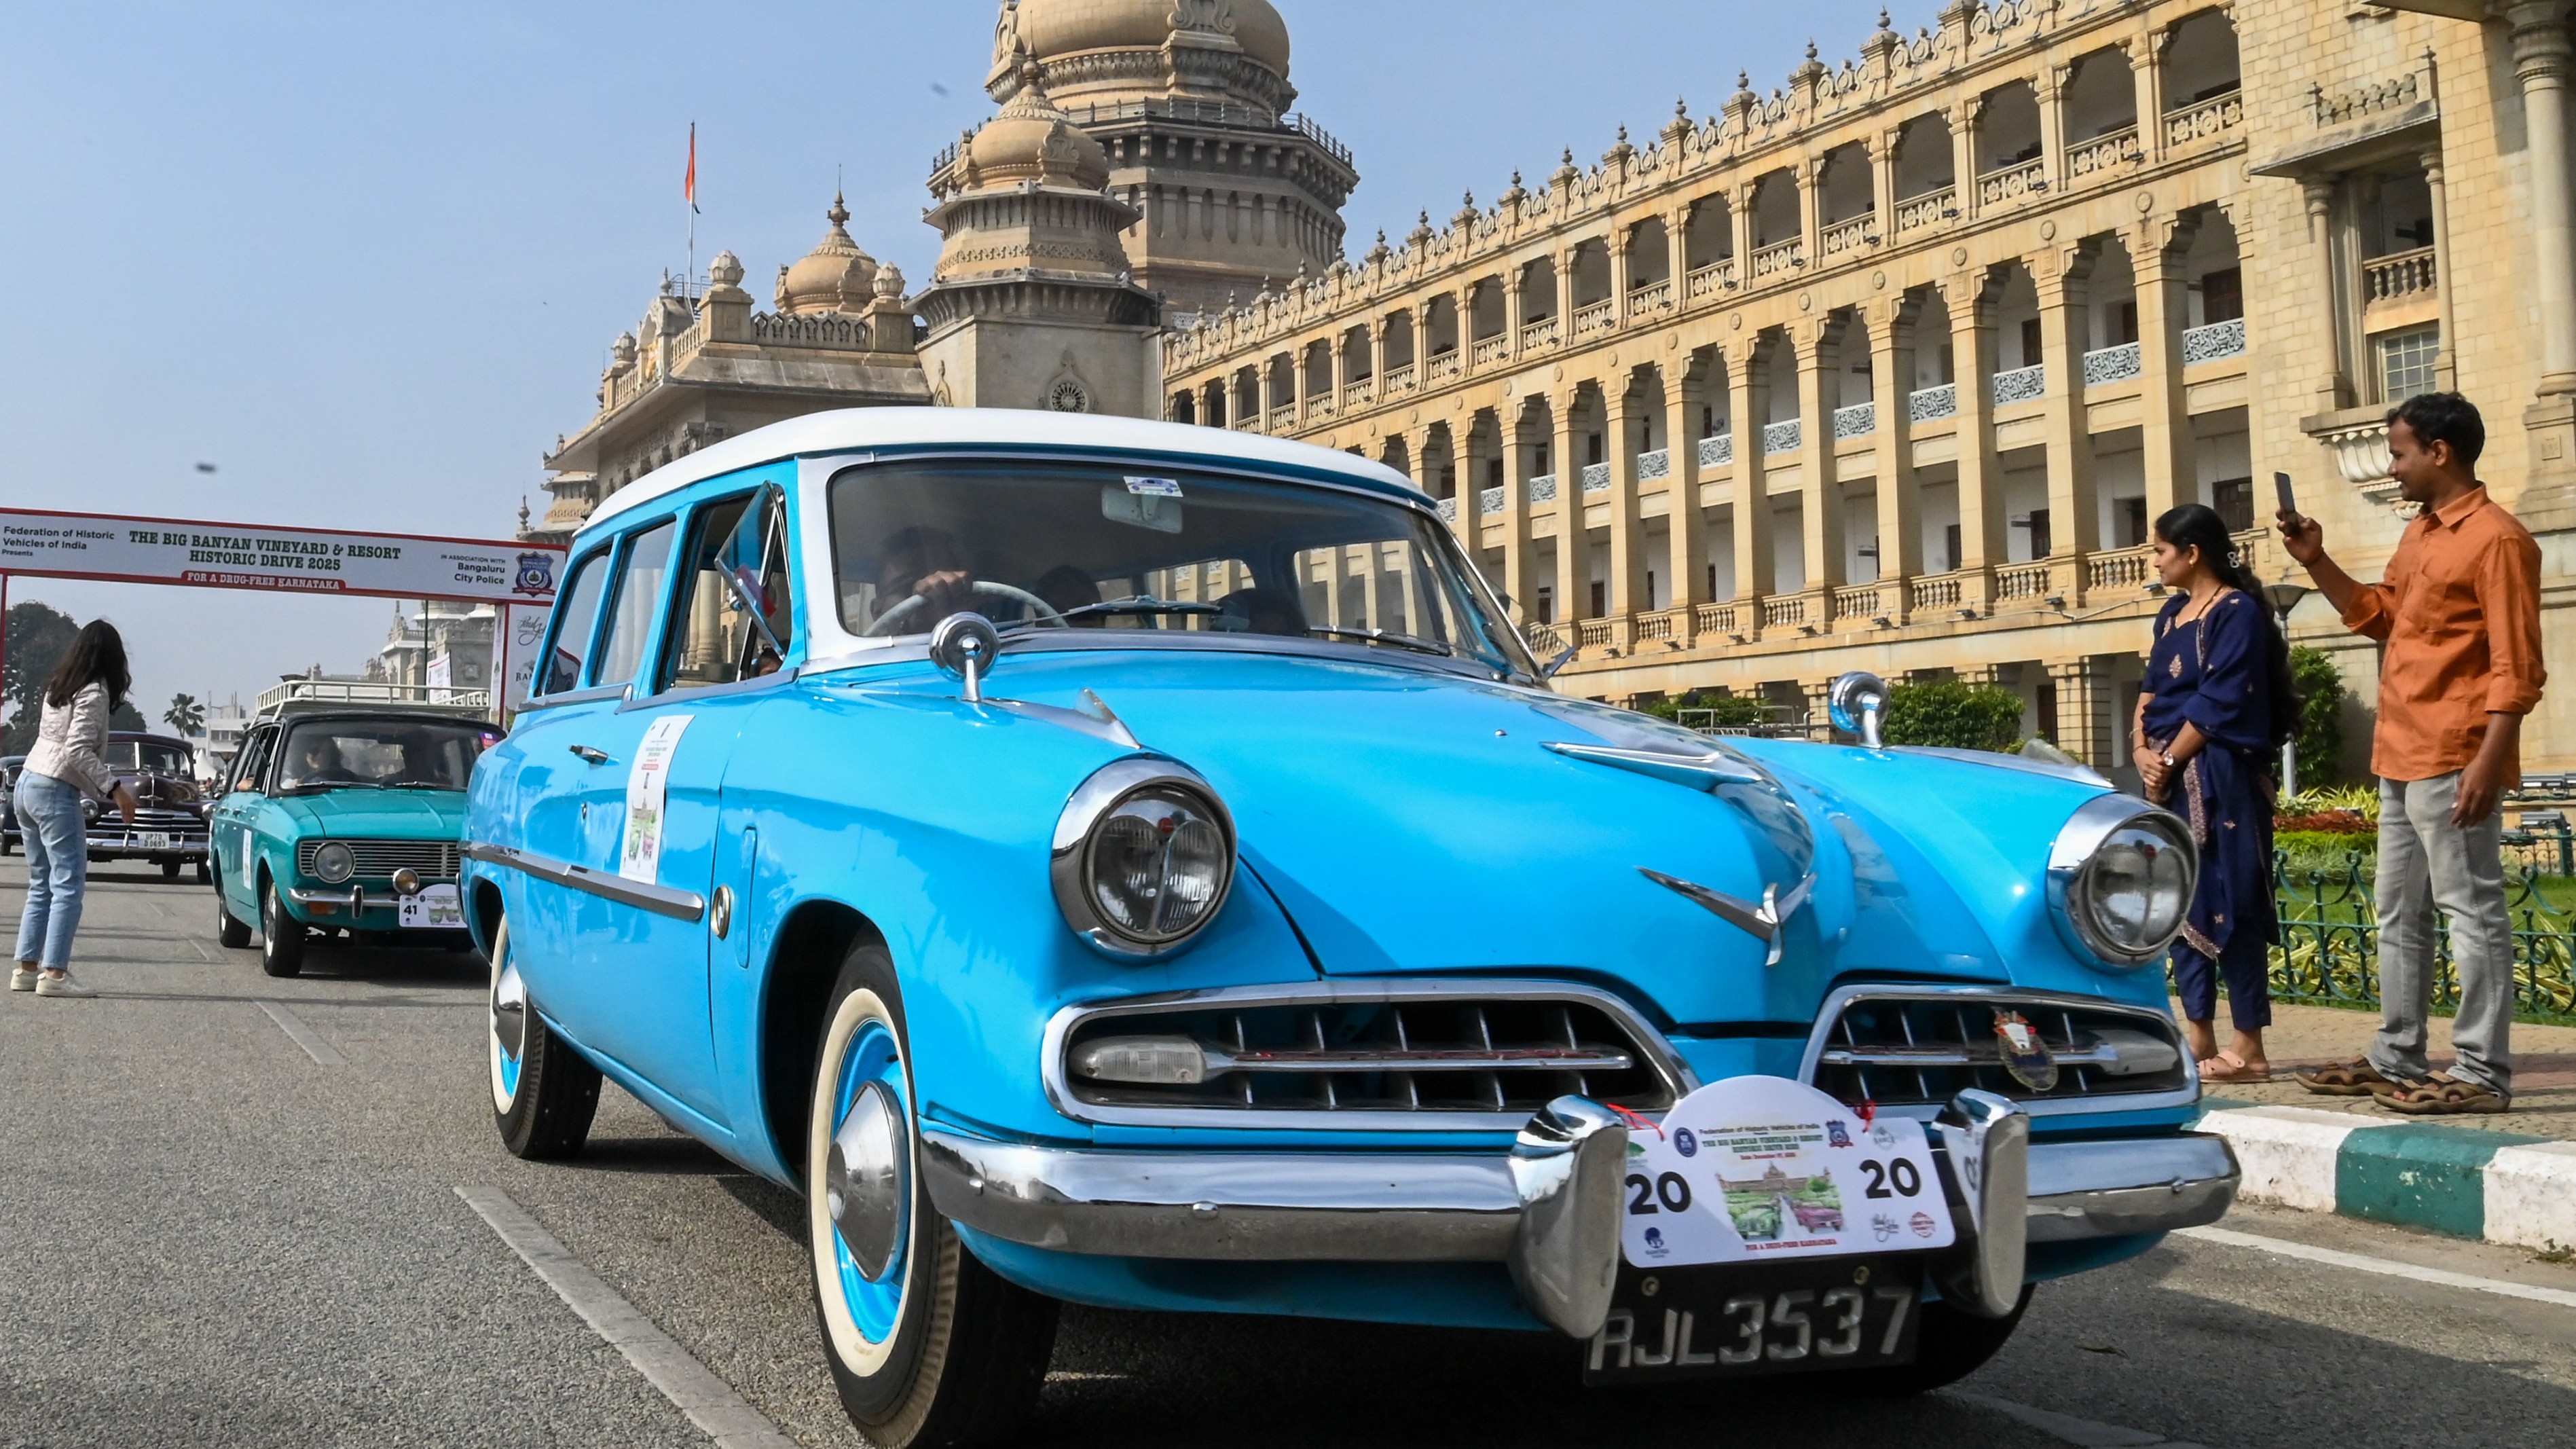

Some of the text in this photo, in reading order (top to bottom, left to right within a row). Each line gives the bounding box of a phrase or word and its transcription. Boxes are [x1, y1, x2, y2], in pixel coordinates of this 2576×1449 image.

[4, 526, 59, 537] Federation
[76, 530, 115, 540] Historic
[3, 537, 87, 550] Vehicles of India
[130, 530, 401, 560] THE BIG BANYAN VINEYARD & RESORT
[1, 549, 33, 557] Presents
[449, 555, 488, 563] ASSOCIATION
[189, 550, 341, 571] HISTORIC DRIVE 2025
[457, 562, 505, 574] Bangaluru
[187, 572, 339, 590] FOR A DRUG-FREE KARNATAKA
[454, 573, 504, 585] City Police
[403, 904, 418, 915] 41
[1859, 1157, 1921, 1199] 20
[1624, 1171, 1691, 1215] 20
